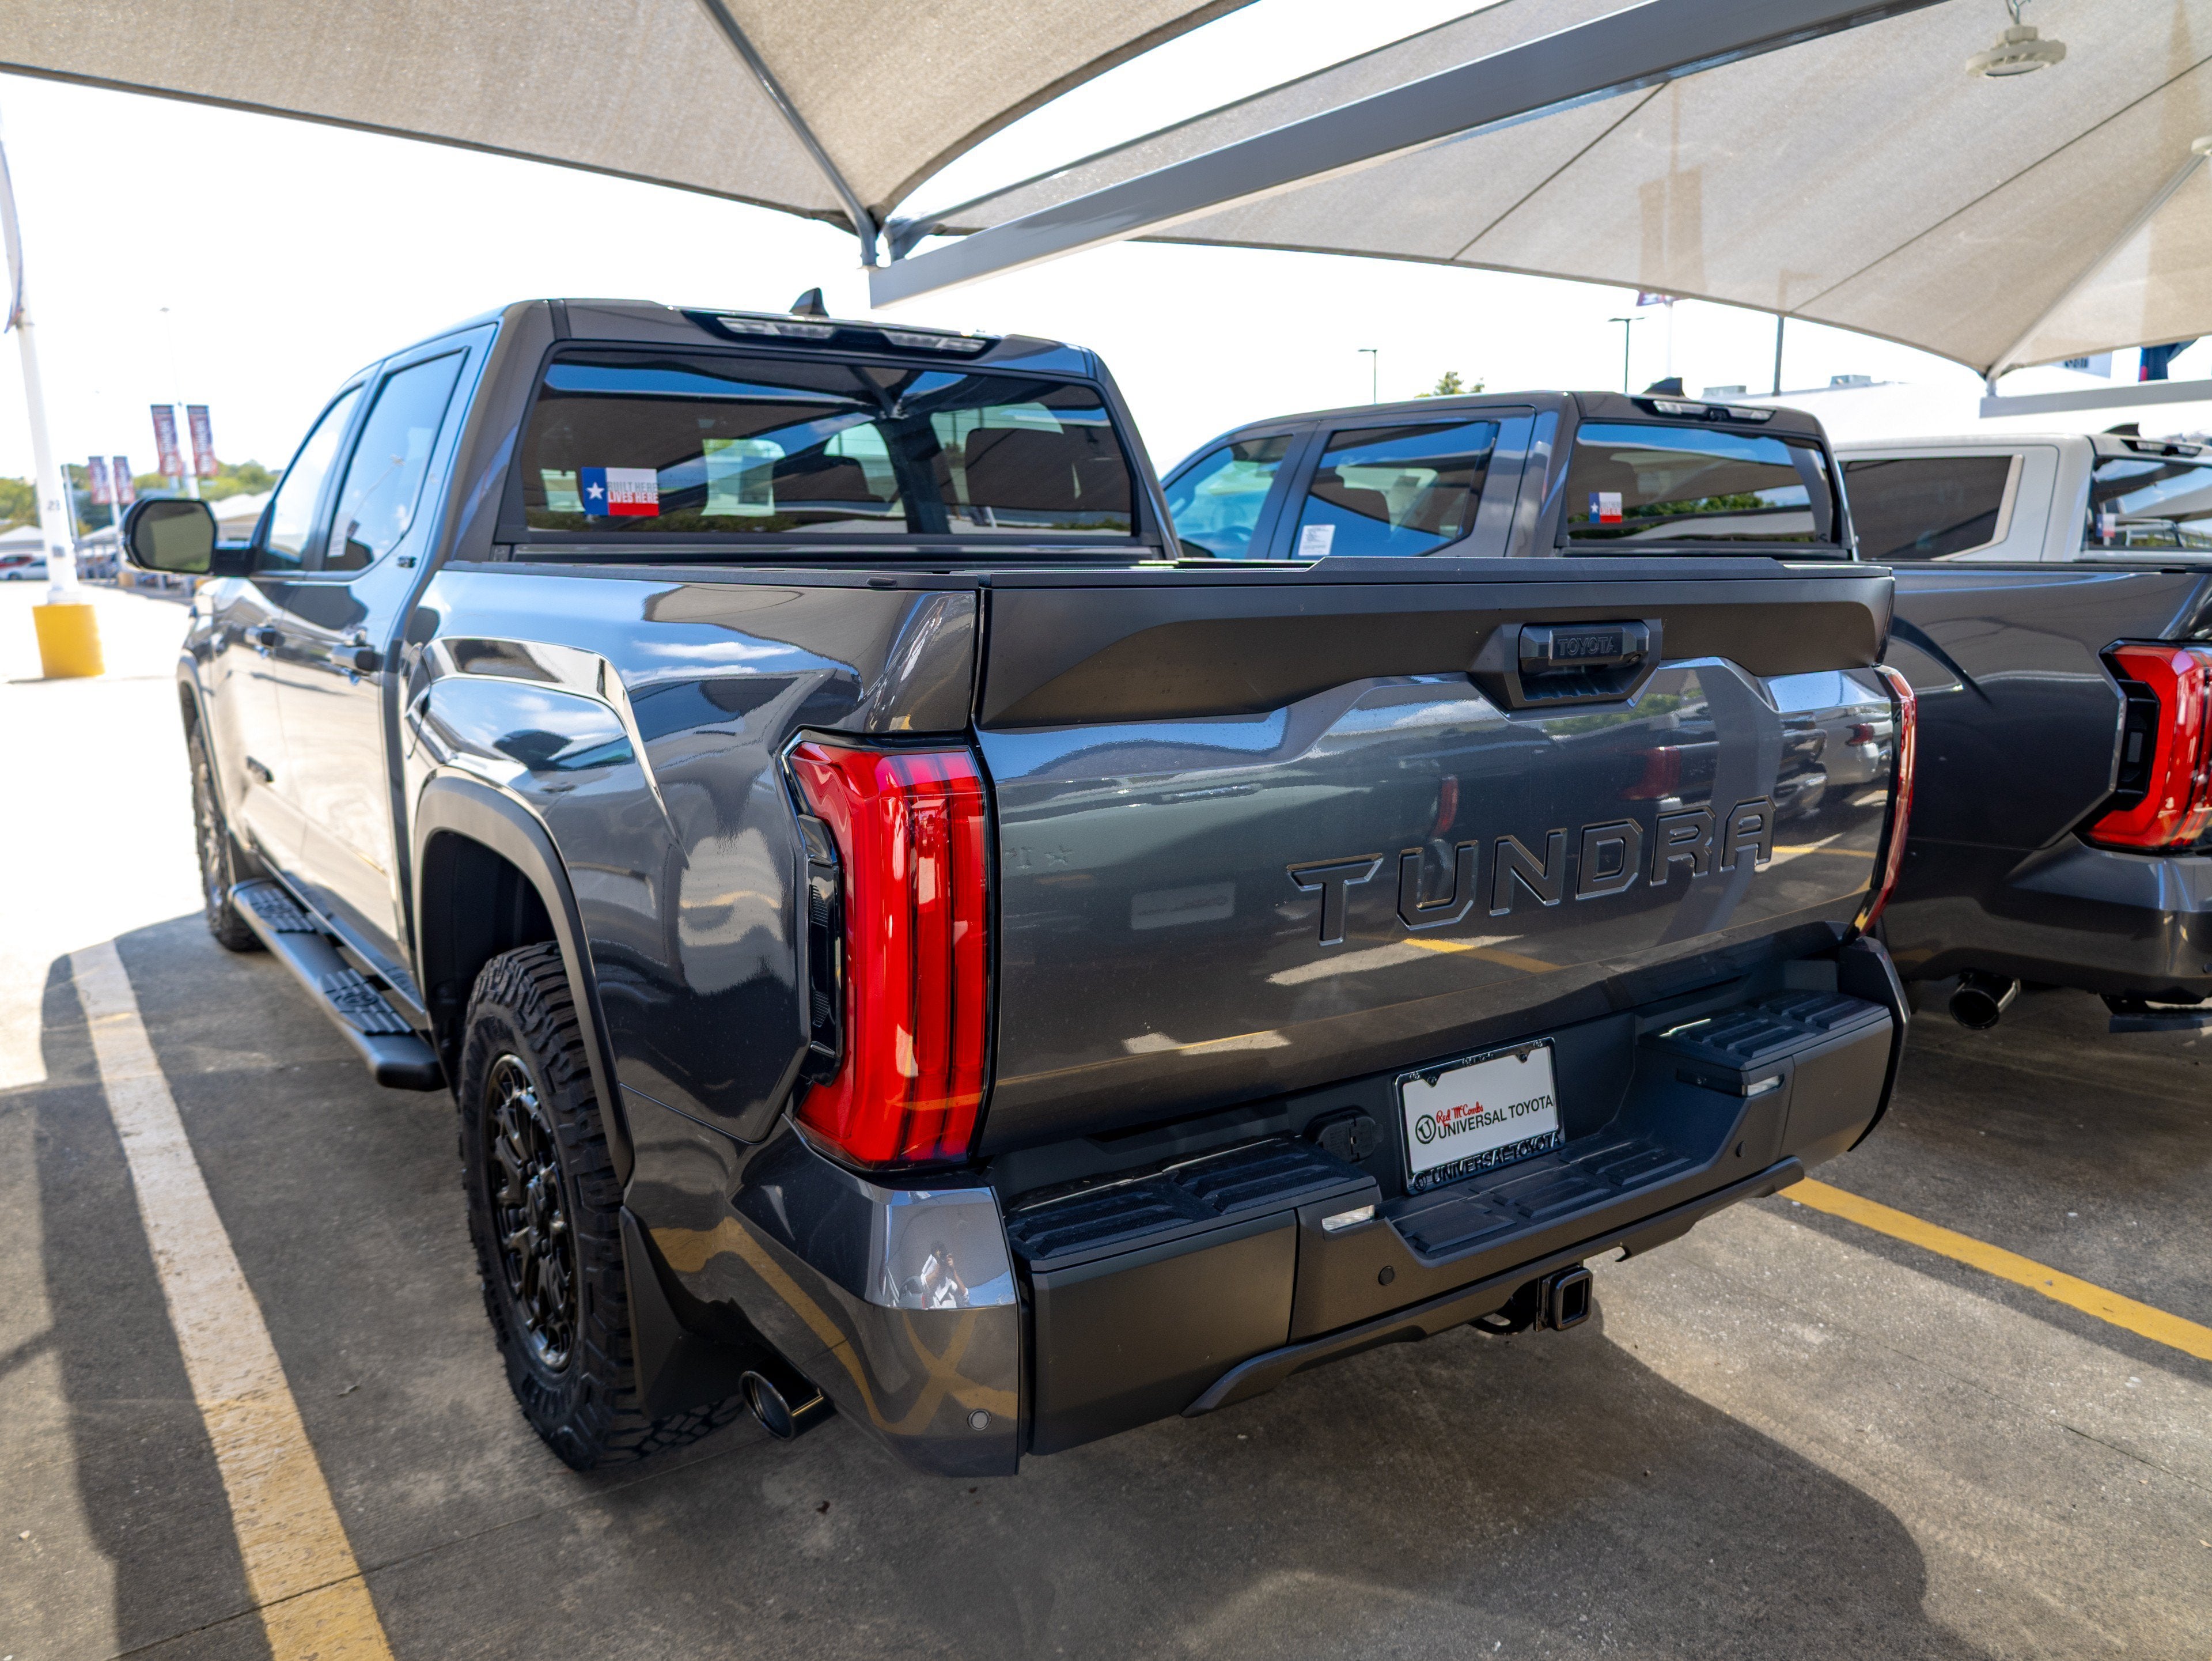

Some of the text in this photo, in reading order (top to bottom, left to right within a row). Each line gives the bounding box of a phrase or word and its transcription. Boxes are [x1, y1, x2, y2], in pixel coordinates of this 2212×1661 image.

[608, 491, 659, 504] LIVES HERE
[635, 482, 658, 493] HERE
[1557, 636, 1618, 656] TOYOTA
[1286, 794, 1777, 947] TUNDRA
[1436, 1101, 1483, 1126] Red McCombs
[1438, 1094, 1554, 1139] UNIVERSAL TOYOTA
[1430, 1132, 1560, 1184] UNIVERSAL TOYOTA
